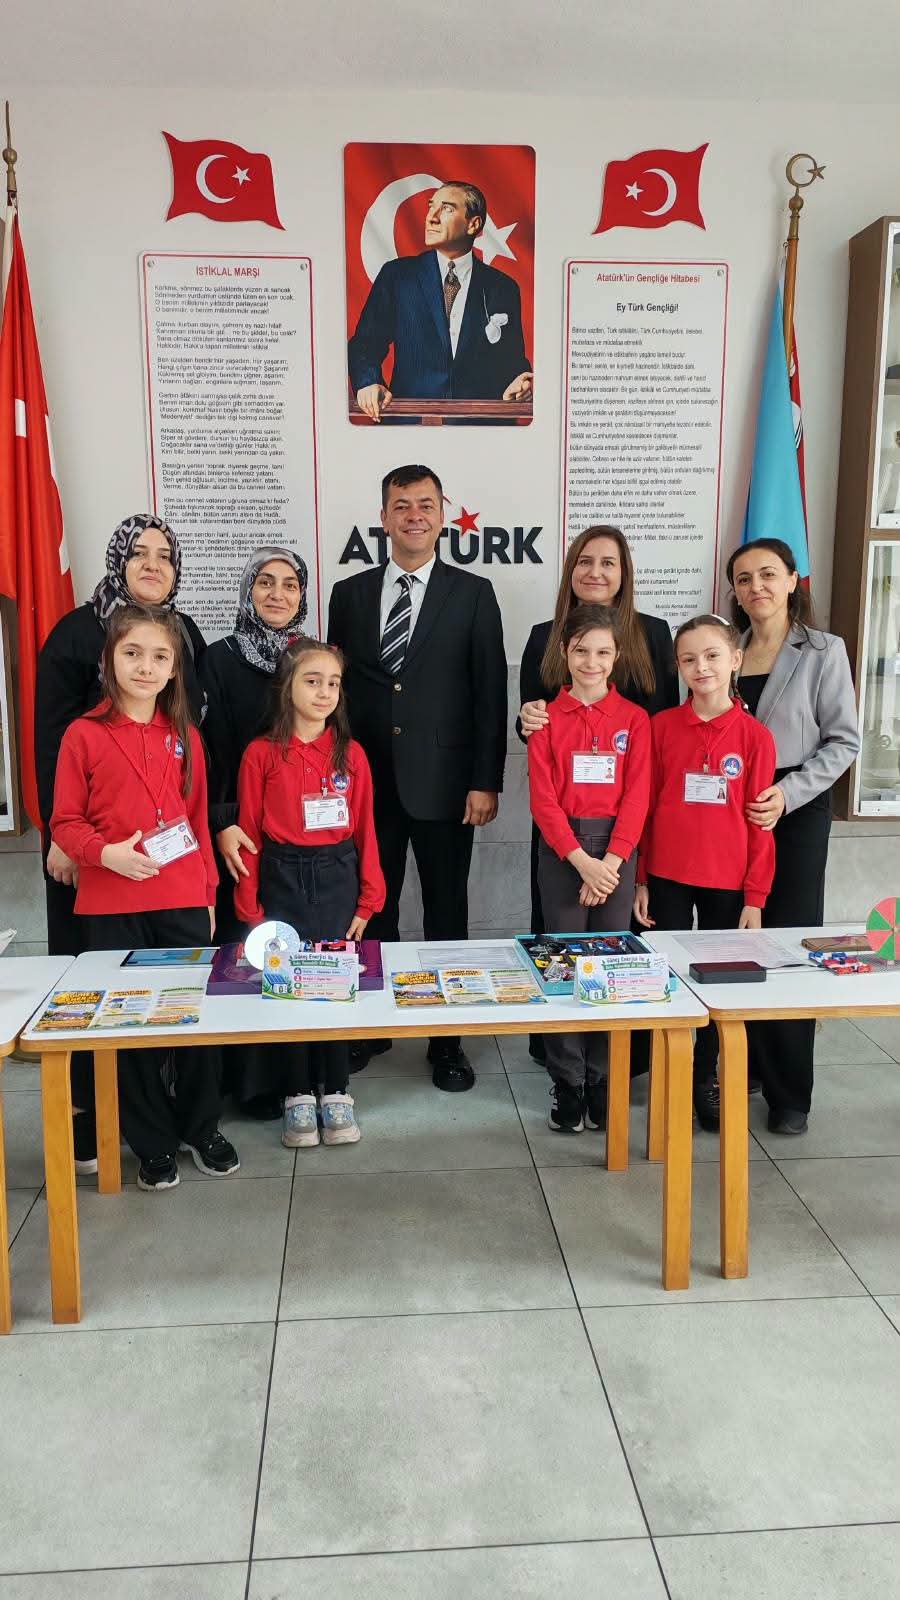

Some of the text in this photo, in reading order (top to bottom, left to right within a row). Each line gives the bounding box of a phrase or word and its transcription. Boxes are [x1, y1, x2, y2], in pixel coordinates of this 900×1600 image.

[234, 267, 260, 278] MARŞI
[596, 273, 700, 284] Atatürk'ün Gençliğe Hitabesi
[616, 303, 678, 313] Ey Türk Gençliği!
